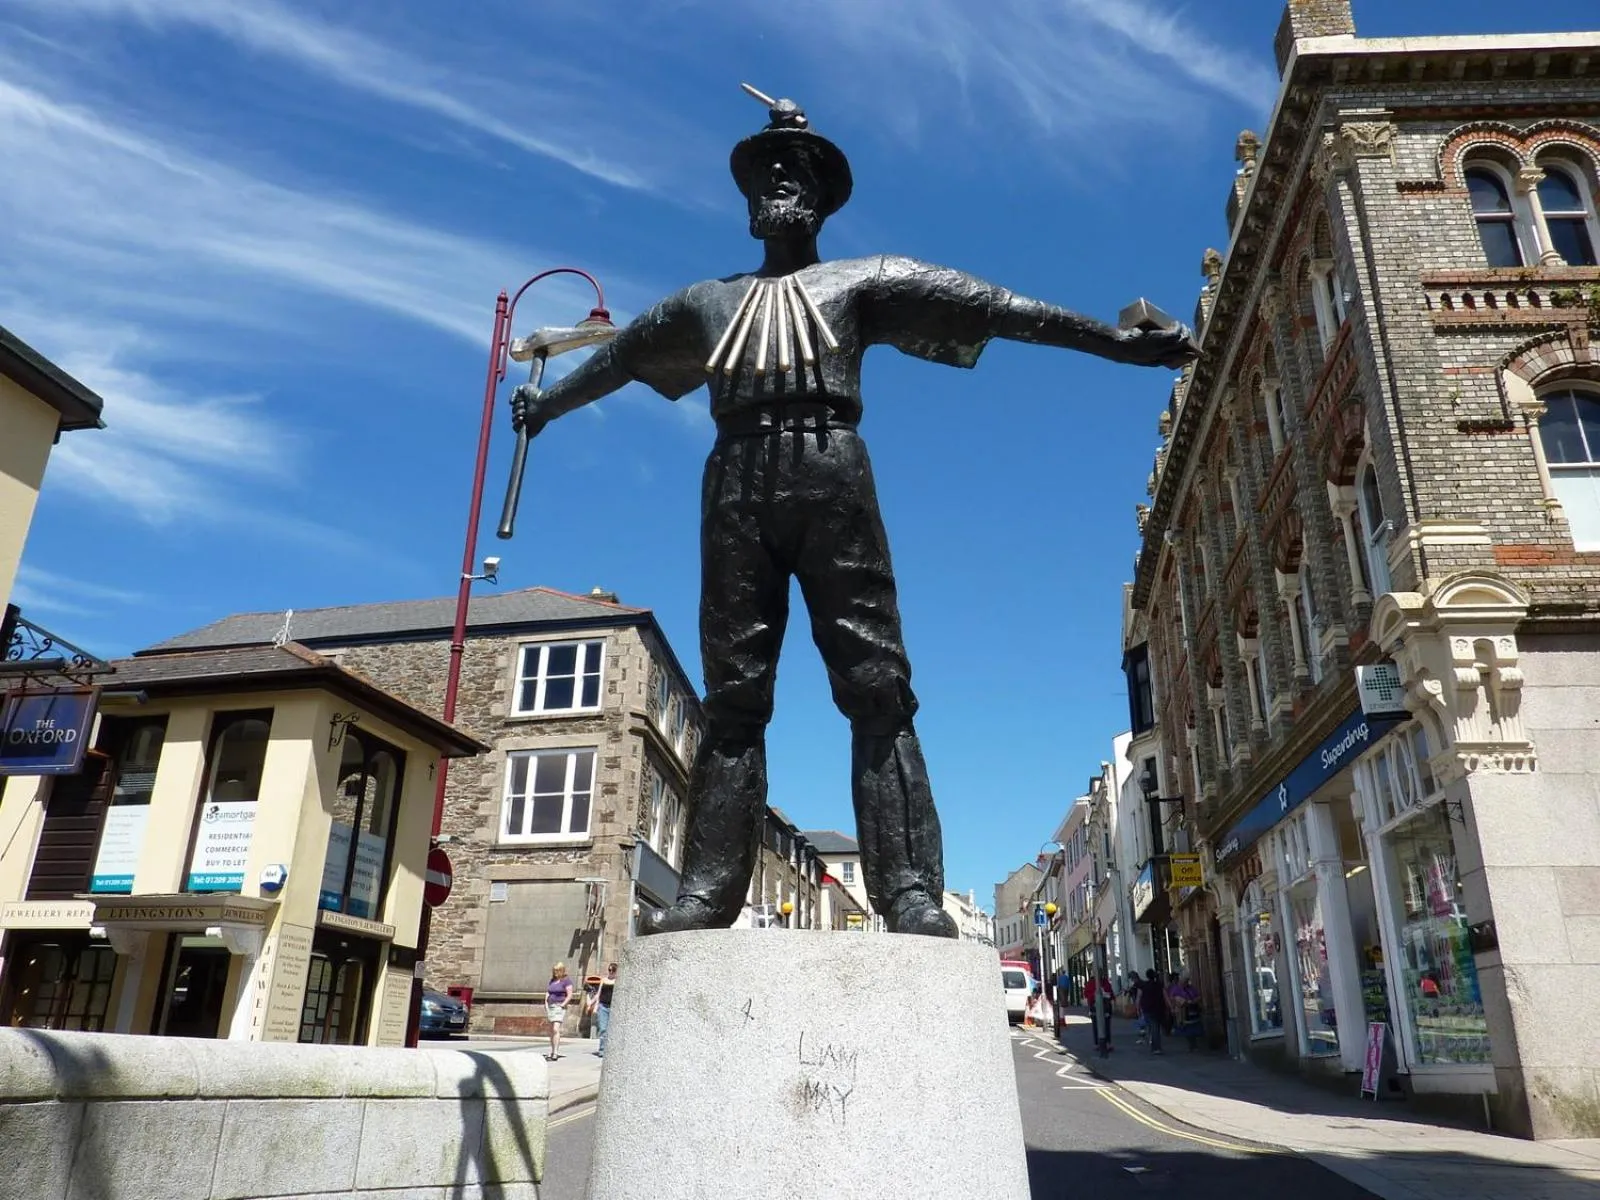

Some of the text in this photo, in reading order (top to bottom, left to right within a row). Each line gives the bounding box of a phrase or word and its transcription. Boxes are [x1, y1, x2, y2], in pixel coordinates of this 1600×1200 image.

[36, 719, 56, 729] THE
[9, 727, 77, 745] OXFORD
[1321, 722, 1370, 769] Superdrug
[205, 846, 248, 854] COMMERCIA
[205, 859, 248, 867] BUY TO LET
[5, 909, 91, 918] JEWELLERY REPA
[109, 907, 205, 918] LIVINGSTON'S
[224, 909, 264, 920] JEWELLERS
